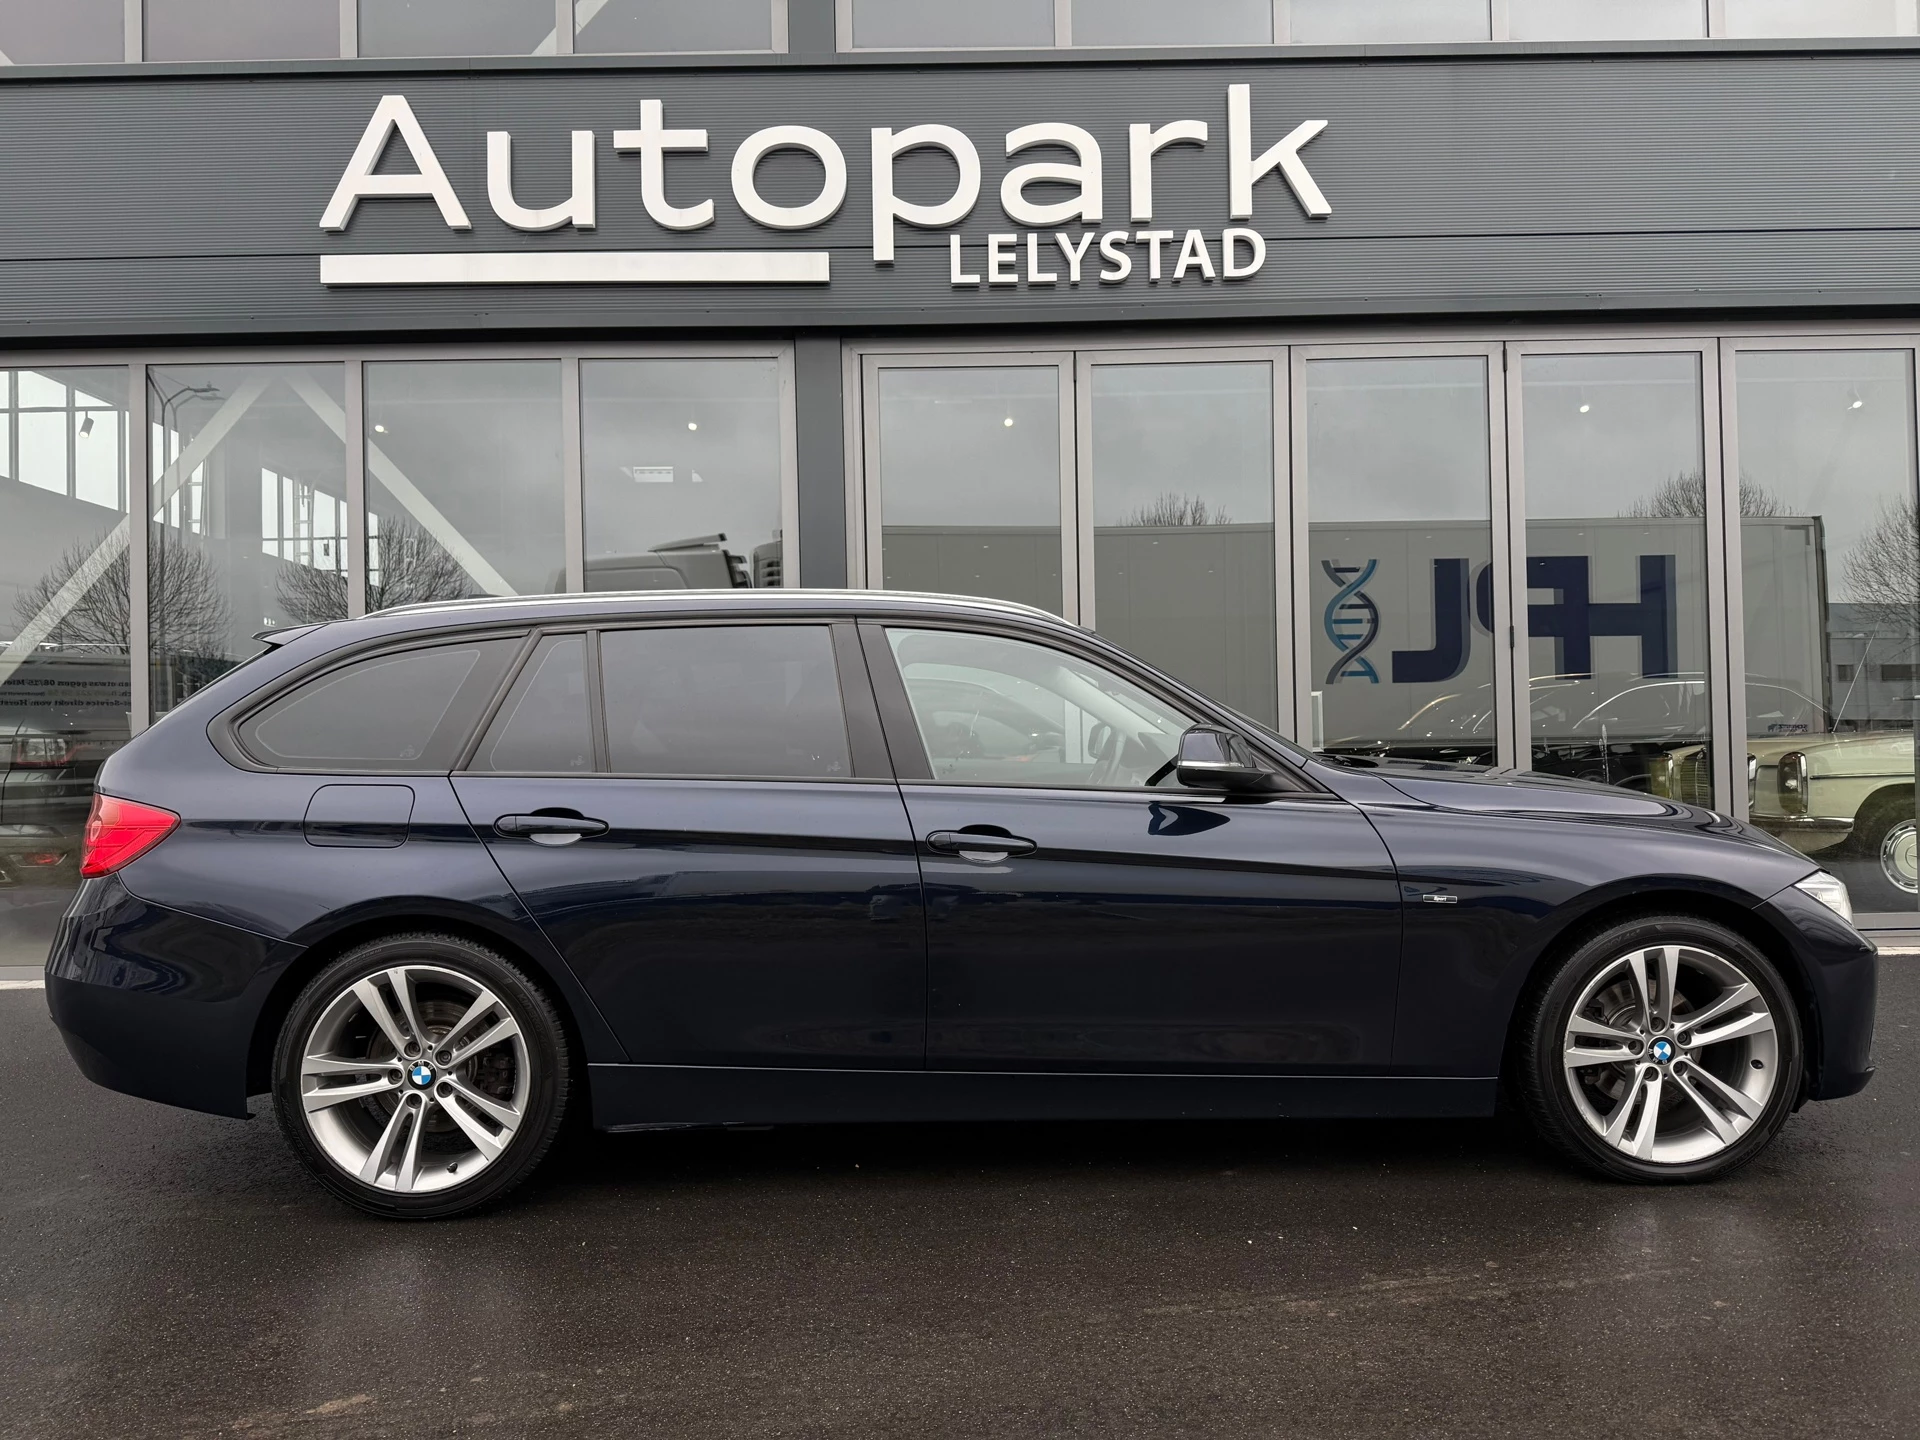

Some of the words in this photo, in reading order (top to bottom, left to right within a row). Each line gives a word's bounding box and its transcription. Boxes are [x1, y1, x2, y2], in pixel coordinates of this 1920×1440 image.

[319, 83, 1333, 264] Autopark
[950, 228, 1267, 284] LELYSTAD
[409, 1060, 434, 1071] BMW
